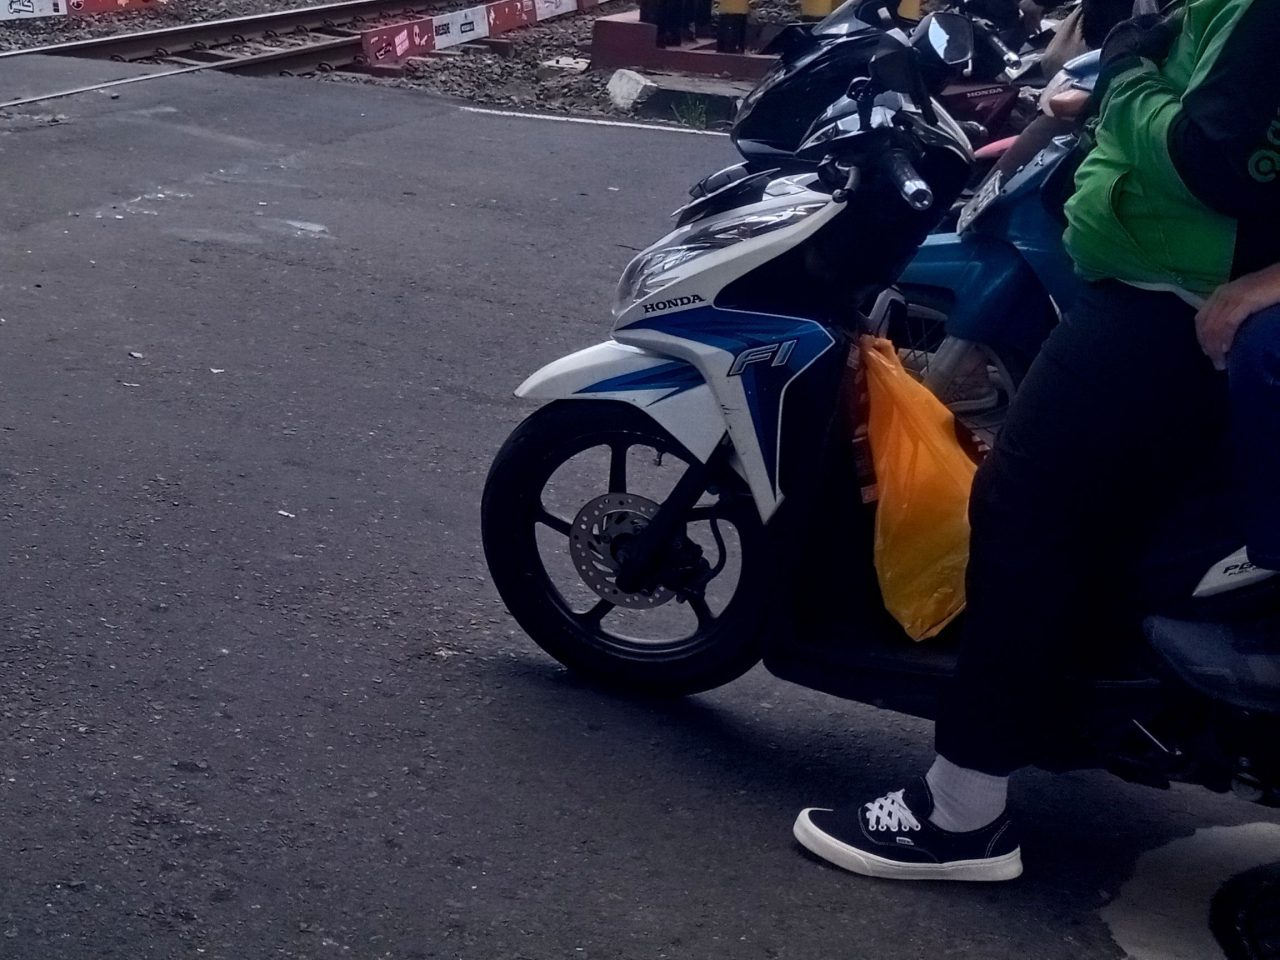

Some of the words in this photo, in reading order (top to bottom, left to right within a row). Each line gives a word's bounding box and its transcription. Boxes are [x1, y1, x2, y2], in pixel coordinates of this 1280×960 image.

[966, 87, 1004, 98] HONDA
[642, 294, 707, 314] HONDA
[726, 339, 798, 377] FI
